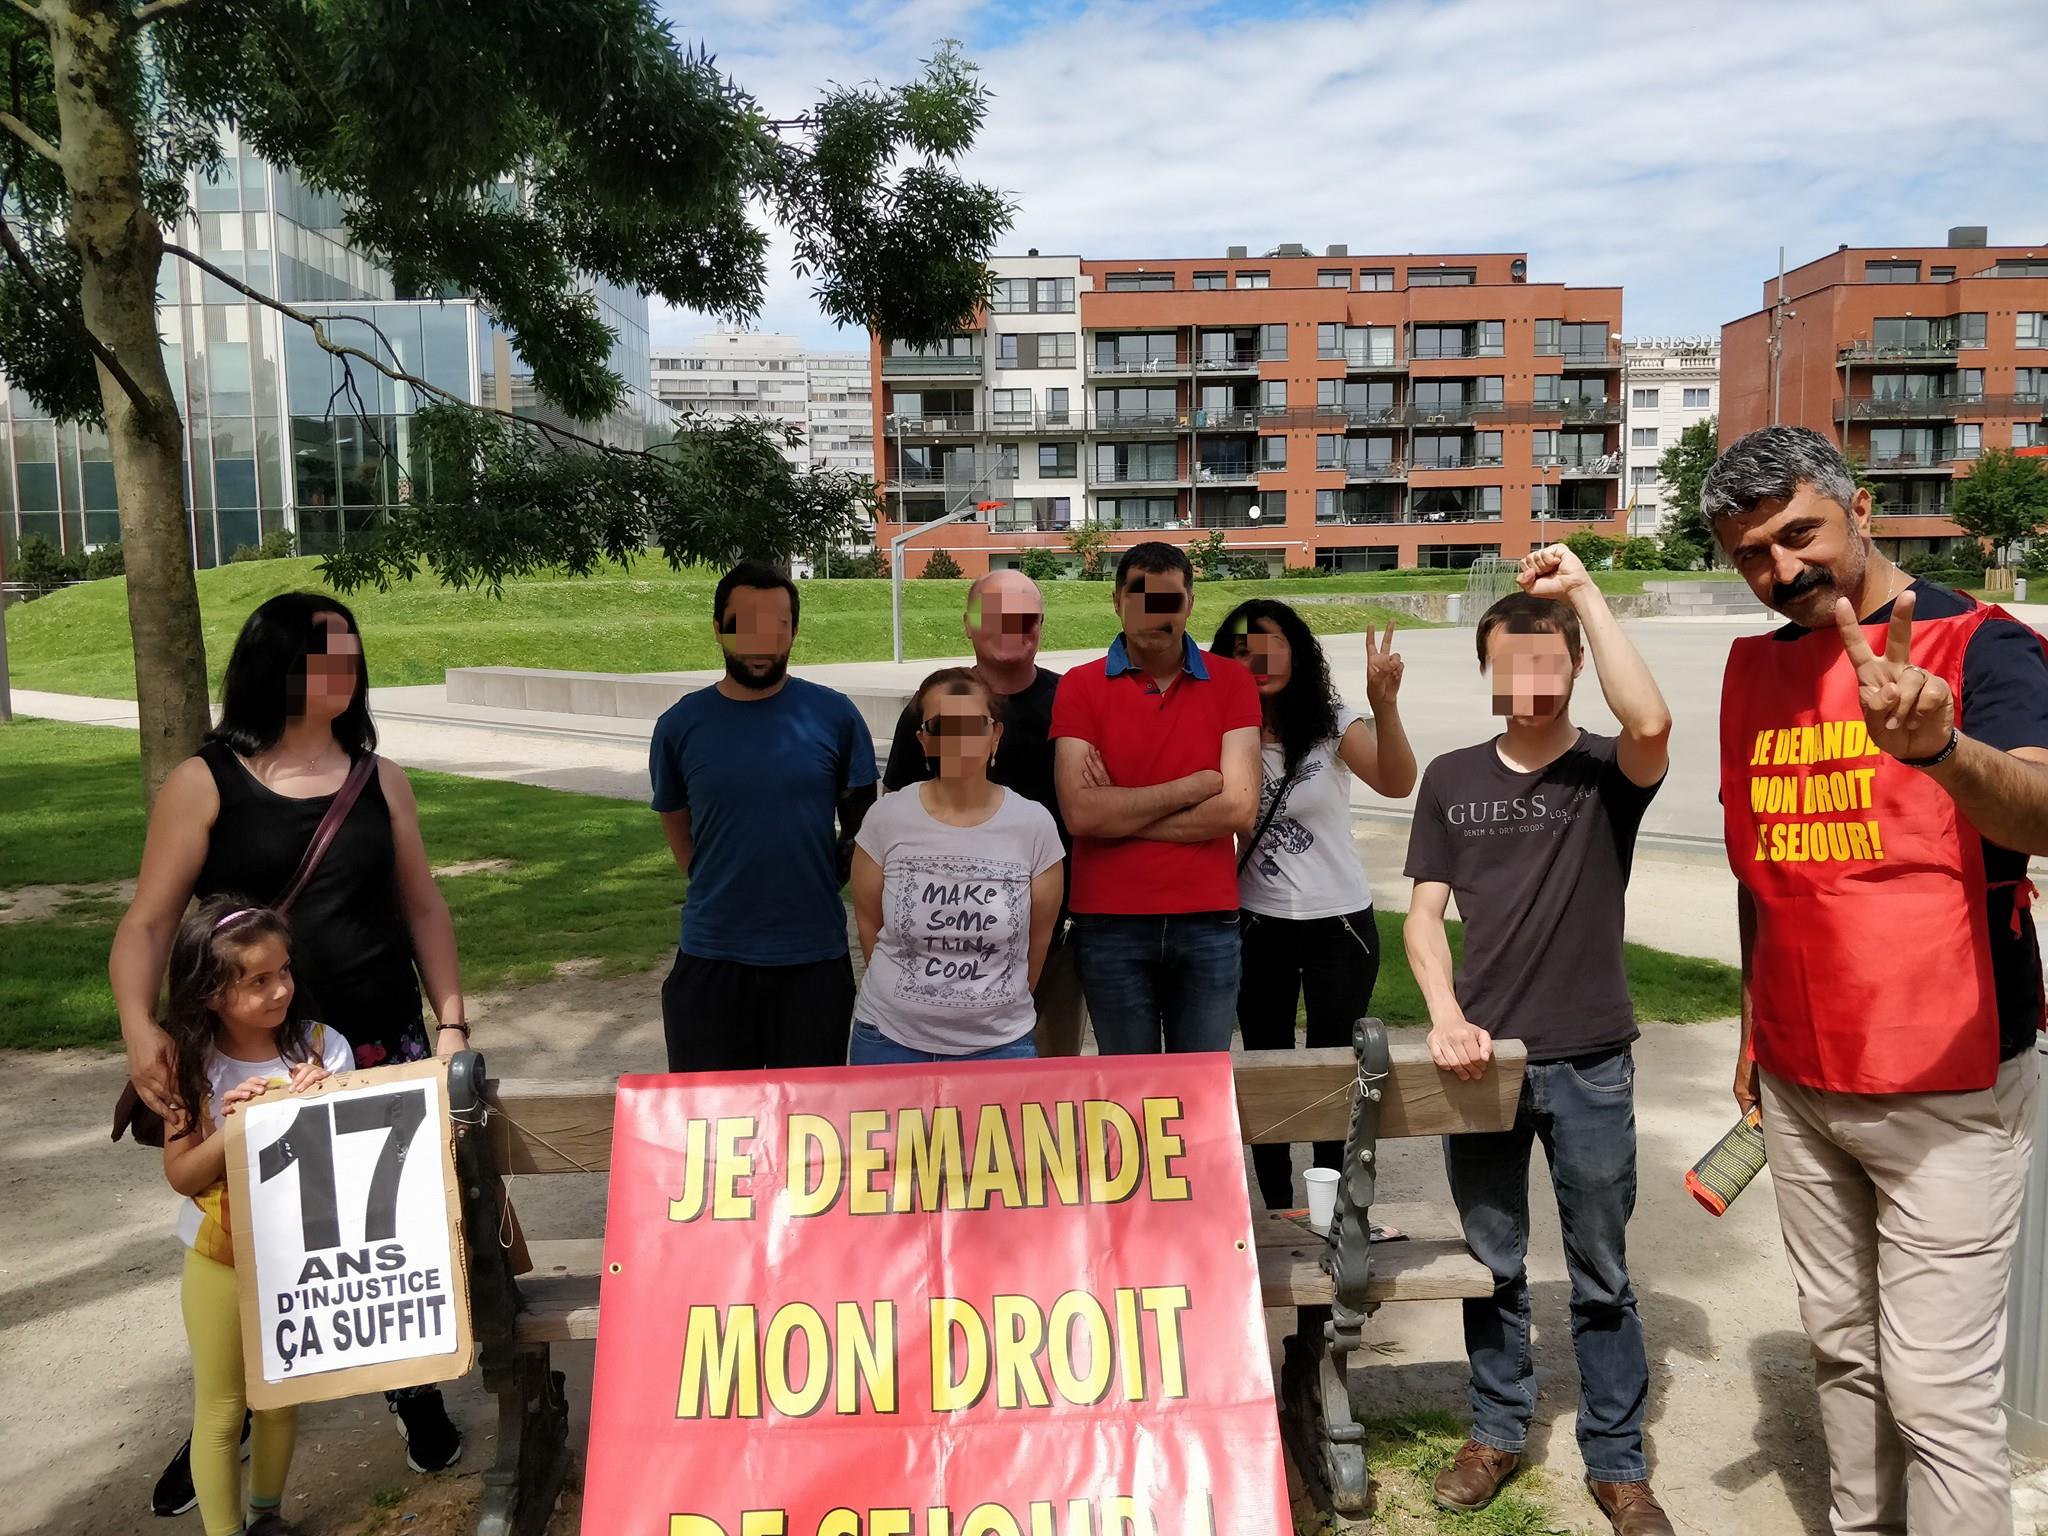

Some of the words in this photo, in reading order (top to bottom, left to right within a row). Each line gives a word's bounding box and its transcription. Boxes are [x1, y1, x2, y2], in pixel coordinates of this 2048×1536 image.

[1750, 730, 1774, 766] JE
[1447, 794, 1547, 825] GUESS
[1751, 775, 1798, 814] MON
[1803, 768, 1876, 814] DROIT
[1463, 828, 1486, 837] DENIM
[1500, 826, 1514, 835] DRY
[1519, 823, 1545, 833] GOODS
[1770, 820, 1885, 862] SEJOUR!
[925, 957, 989, 980] COOL
[259, 1087, 427, 1252] 17
[667, 1116, 757, 1223] JE
[786, 1096, 1194, 1218] DEMANDE
[297, 1243, 407, 1285] ANS
[276, 1268, 441, 1315] D'INJUSTICE
[275, 1314, 324, 1372] ÇA
[333, 1294, 446, 1351] SUFFIT
[674, 1299, 900, 1420] MON
[930, 1285, 1192, 1413] DROIT
